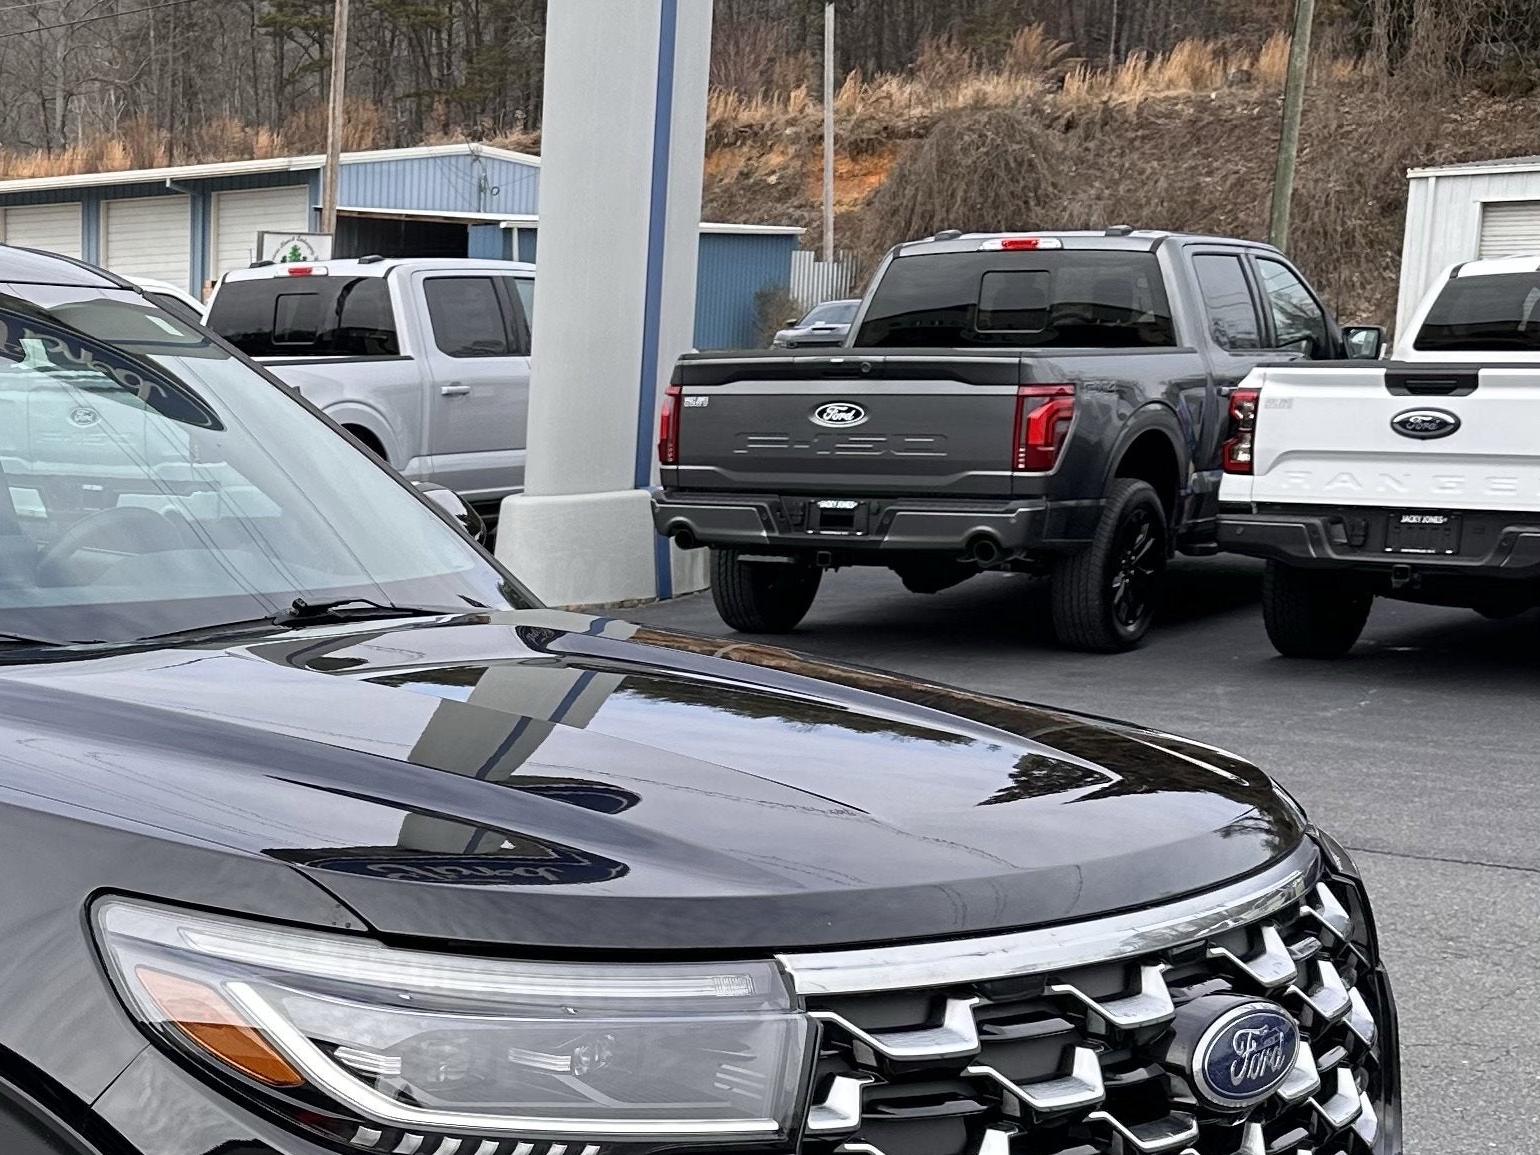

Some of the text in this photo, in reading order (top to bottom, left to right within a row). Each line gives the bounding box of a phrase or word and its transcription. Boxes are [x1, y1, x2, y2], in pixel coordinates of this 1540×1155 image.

[822, 403, 856, 421] Ford
[1406, 416, 1441, 430] Ford
[1280, 470, 1540, 497] RANGE
[1231, 1024, 1286, 1086] Ford
